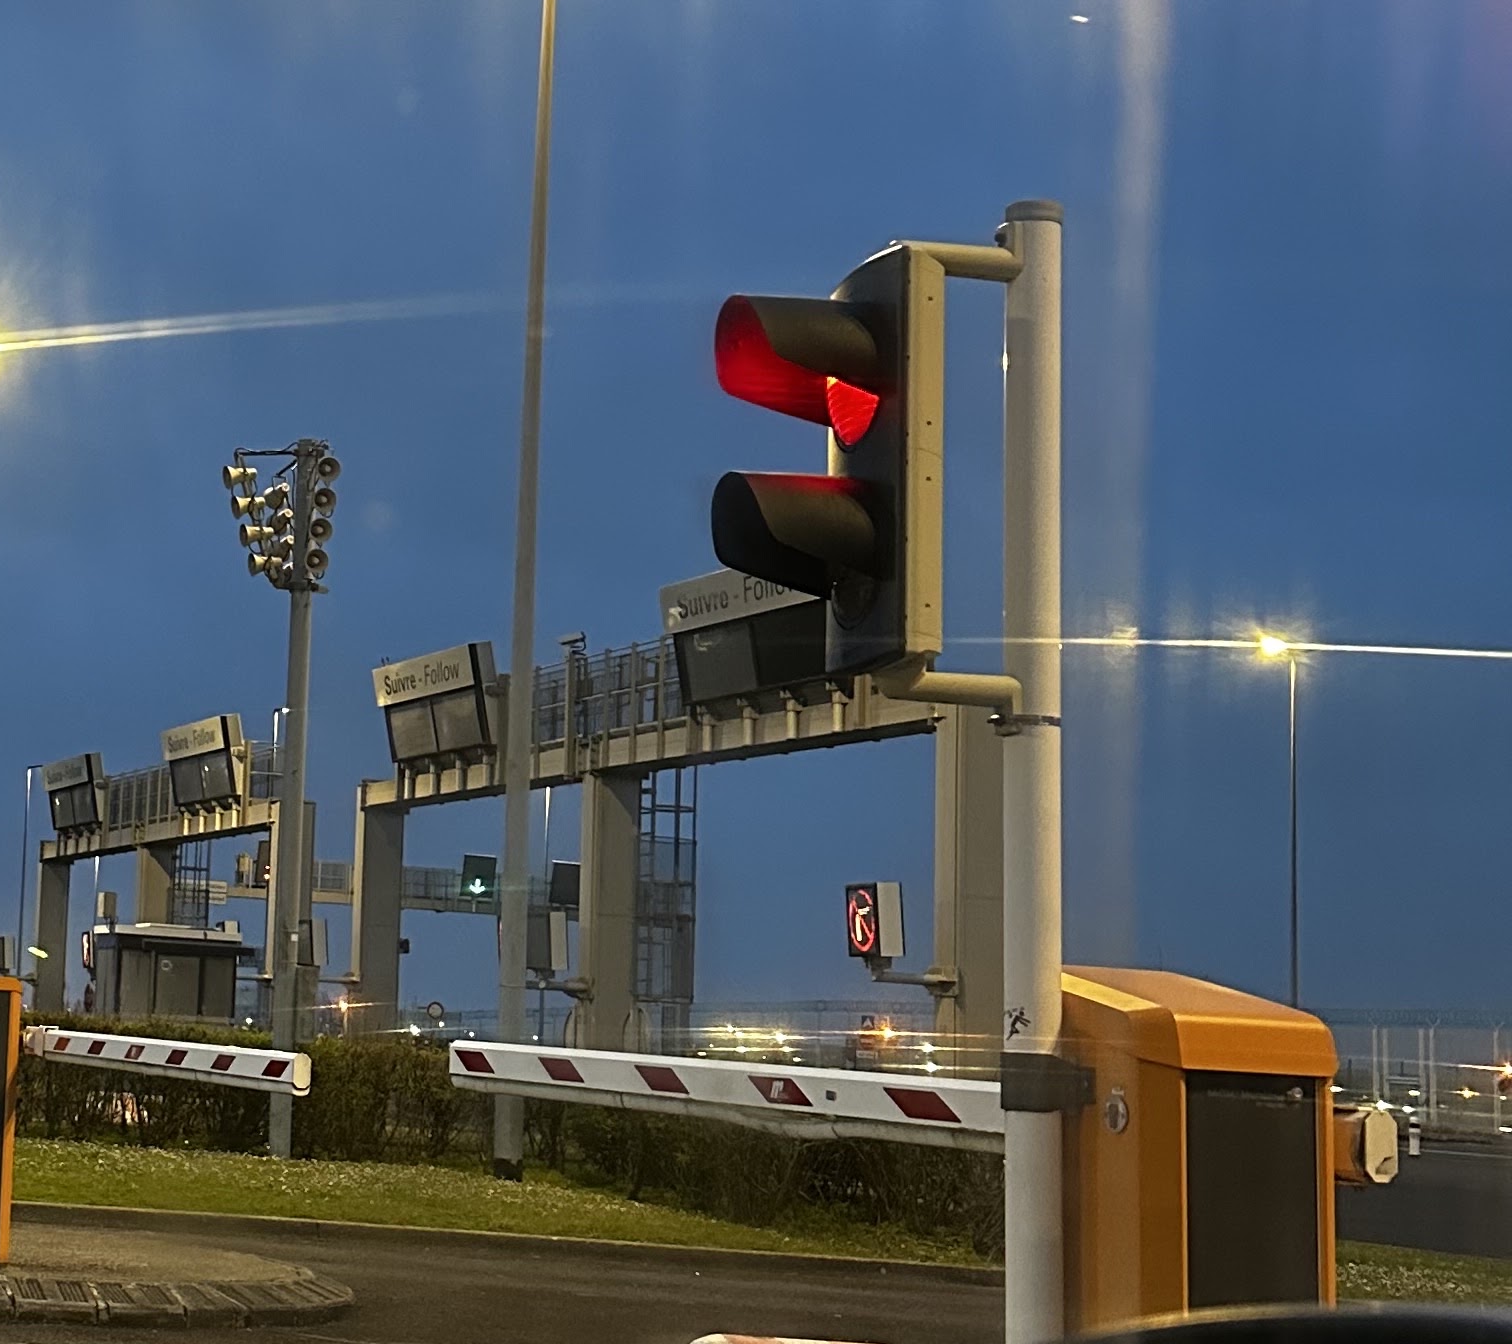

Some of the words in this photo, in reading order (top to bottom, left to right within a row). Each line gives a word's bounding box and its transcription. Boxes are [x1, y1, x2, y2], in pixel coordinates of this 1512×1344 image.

[676, 590, 729, 619] Suivre
[742, 575, 796, 604] Follo
[384, 674, 417, 696] Suivre
[424, 662, 460, 687] Follow
